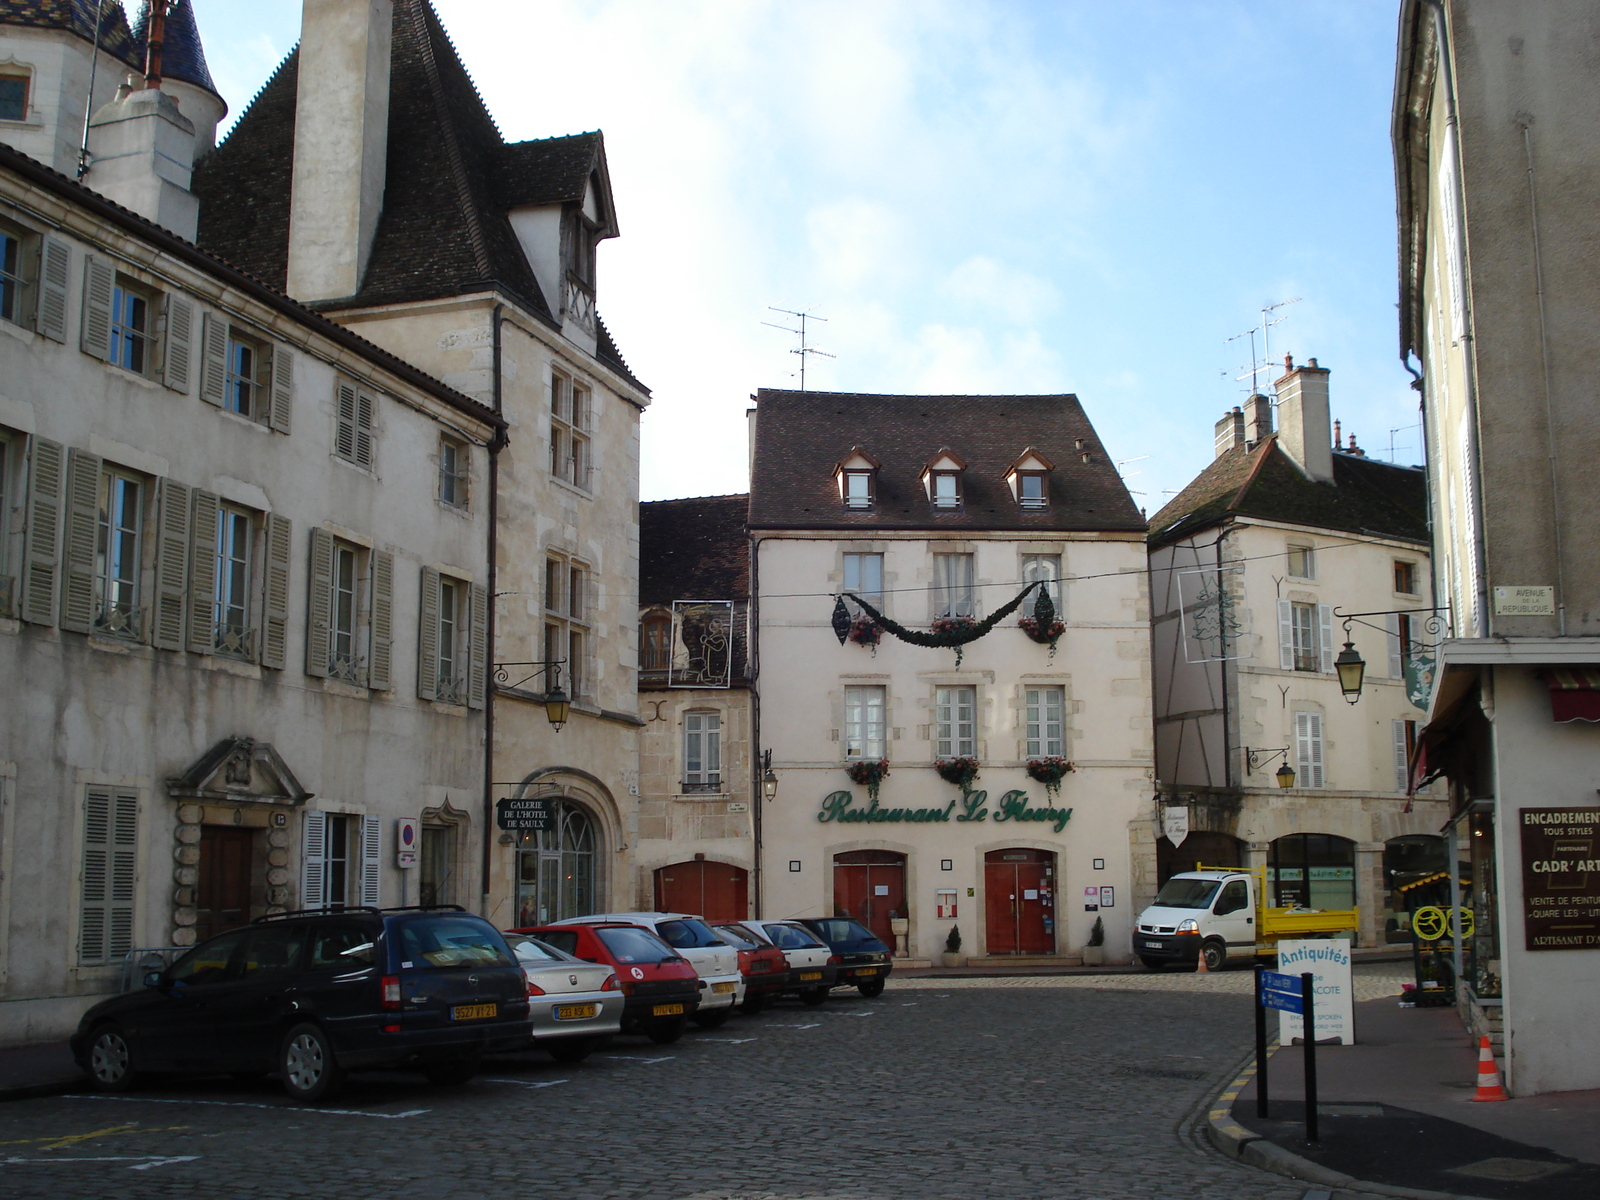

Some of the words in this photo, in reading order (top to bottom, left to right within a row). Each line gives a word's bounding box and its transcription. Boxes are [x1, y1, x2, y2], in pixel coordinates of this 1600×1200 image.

[510, 801, 543, 809] GALERIE
[504, 810, 514, 818] DE
[516, 810, 548, 819] L'HOTEL
[817, 790, 956, 823] Restaurant
[957, 789, 988, 822] Le
[993, 789, 1074, 833] Fleury
[507, 820, 517, 828] DE
[520, 820, 544, 828] SAULX
[1544, 828, 1564, 836] TOUS
[1567, 827, 1593, 835] STYLES
[1530, 897, 1555, 905] VENTE
[1558, 897, 1569, 905] DE
[1571, 896, 1600, 905] PEINTU
[1533, 936, 1583, 946] ARTISANAT
[1280, 945, 1349, 967] Antiquités
[1312, 985, 1341, 995] ACOTE
[455, 1007, 474, 1019] 9527
[485, 1005, 495, 1016] 21
